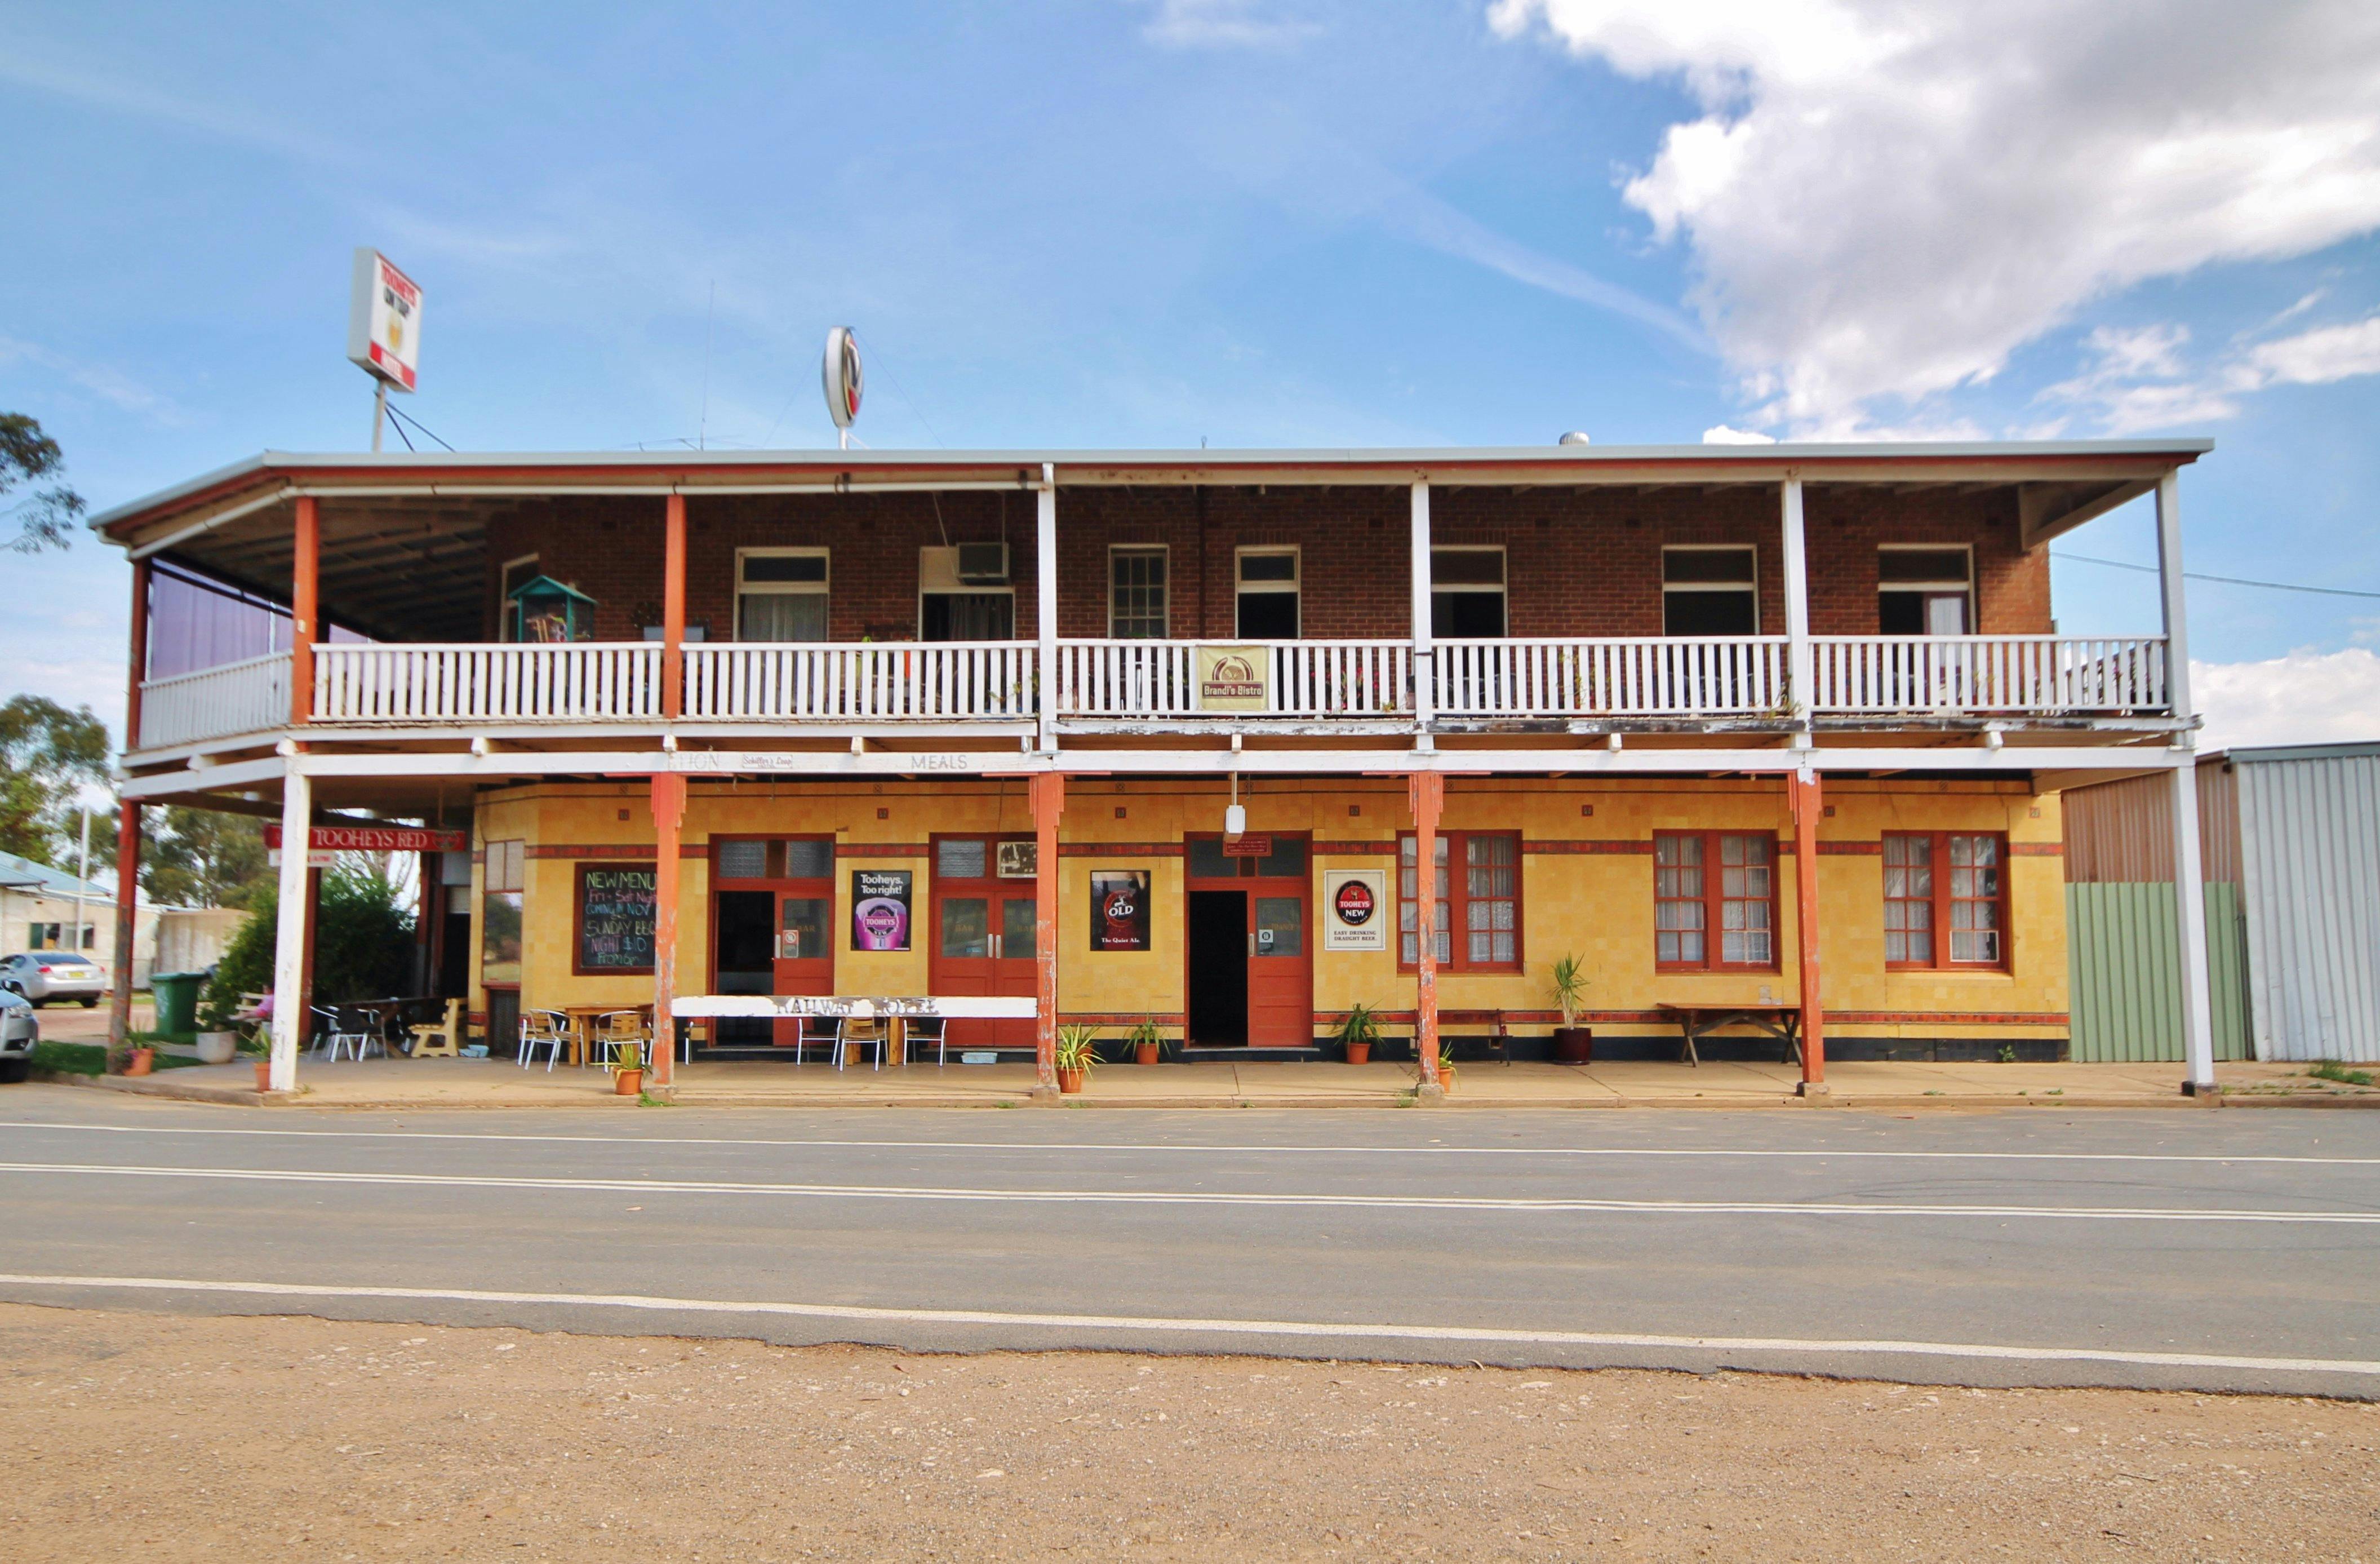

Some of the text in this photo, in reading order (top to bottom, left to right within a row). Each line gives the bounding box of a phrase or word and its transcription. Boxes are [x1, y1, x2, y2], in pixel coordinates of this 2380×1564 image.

[1204, 685, 1262, 695] Brandi's Bistro
[911, 754, 967, 770] MEALS
[314, 828, 428, 848] TOOHEYS RED
[587, 872, 656, 890] NEW MENU
[860, 874, 904, 887] Tooheys.
[636, 890, 656, 907] Nigh
[861, 885, 903, 896] Too right!
[1108, 905, 1134, 916] OLD
[586, 920, 632, 937] SUNDAY
